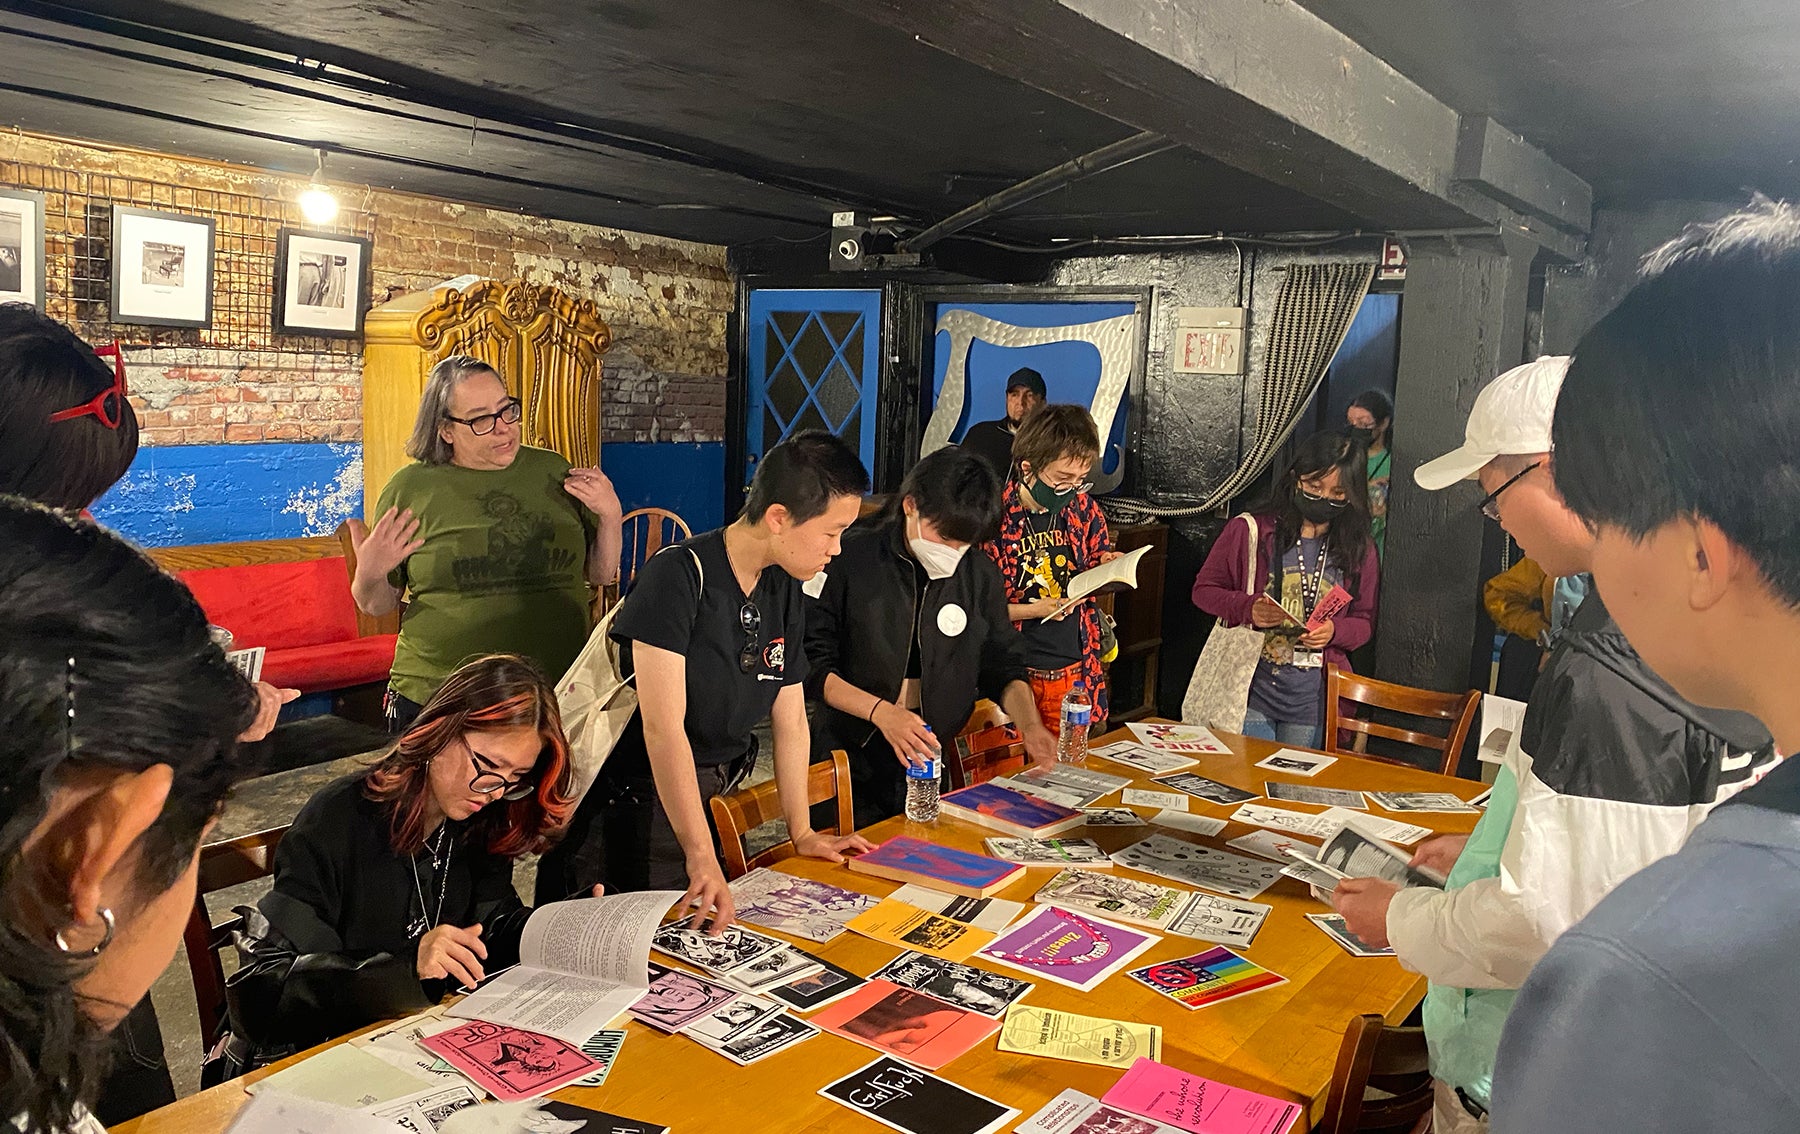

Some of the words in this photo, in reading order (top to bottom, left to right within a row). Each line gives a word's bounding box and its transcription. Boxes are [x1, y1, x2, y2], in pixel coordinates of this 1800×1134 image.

[1184, 333, 1230, 368] EXIT
[1018, 529, 1070, 556] LVINBA
[1171, 979, 1227, 997] COMMUNITY
[1169, 1078, 1191, 1110] whore
[1187, 1081, 1207, 1126] revolution
[1036, 1100, 1070, 1127] Complicated
[1166, 1108, 1185, 1121] the
